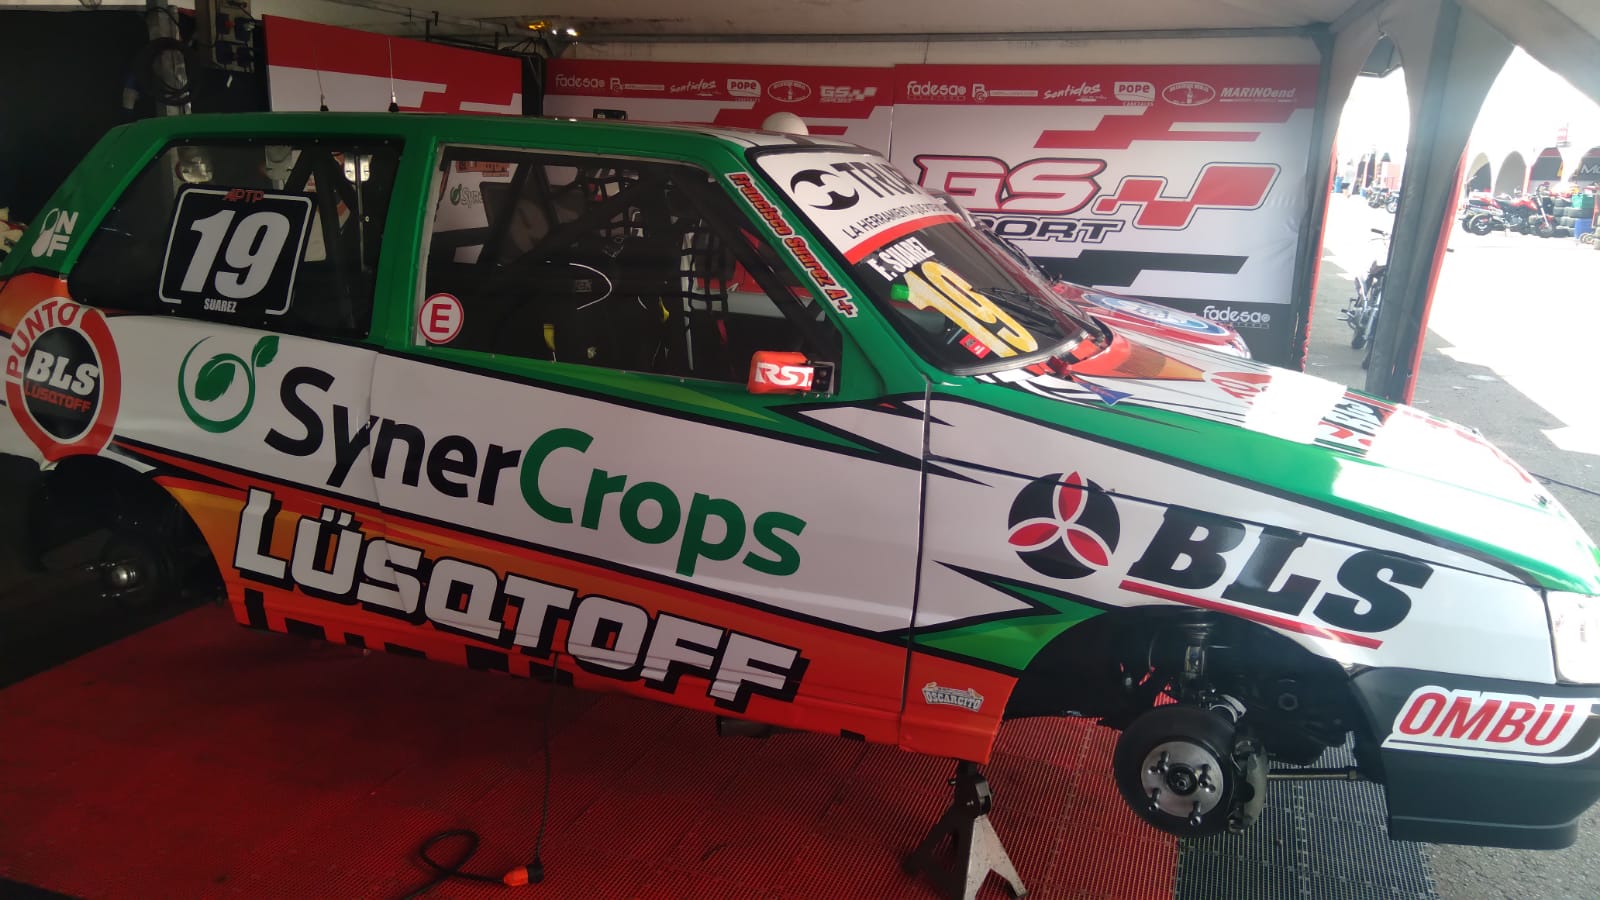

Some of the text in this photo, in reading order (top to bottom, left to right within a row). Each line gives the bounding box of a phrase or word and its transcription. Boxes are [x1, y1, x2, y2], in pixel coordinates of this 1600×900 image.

[907, 80, 960, 96] fadesa
[913, 154, 1107, 216] GS
[729, 173, 792, 236] Francisco
[784, 236, 836, 287] Suarez
[842, 225, 864, 239] LA
[180, 209, 290, 299] 19
[878, 236, 936, 273] SUAREZ
[203, 298, 238, 313] SUAREZ
[429, 304, 451, 333] E
[904, 261, 1039, 358] 19
[1203, 305, 1262, 322] fadesa
[6, 300, 80, 380] PUNTO
[26, 350, 99, 396] BLS
[755, 362, 814, 387] RST
[263, 366, 808, 577] SynerCrops
[1126, 504, 1435, 633] BLS
[926, 690, 981, 710] OSCARCITO
[1398, 692, 1576, 747] OMBU
